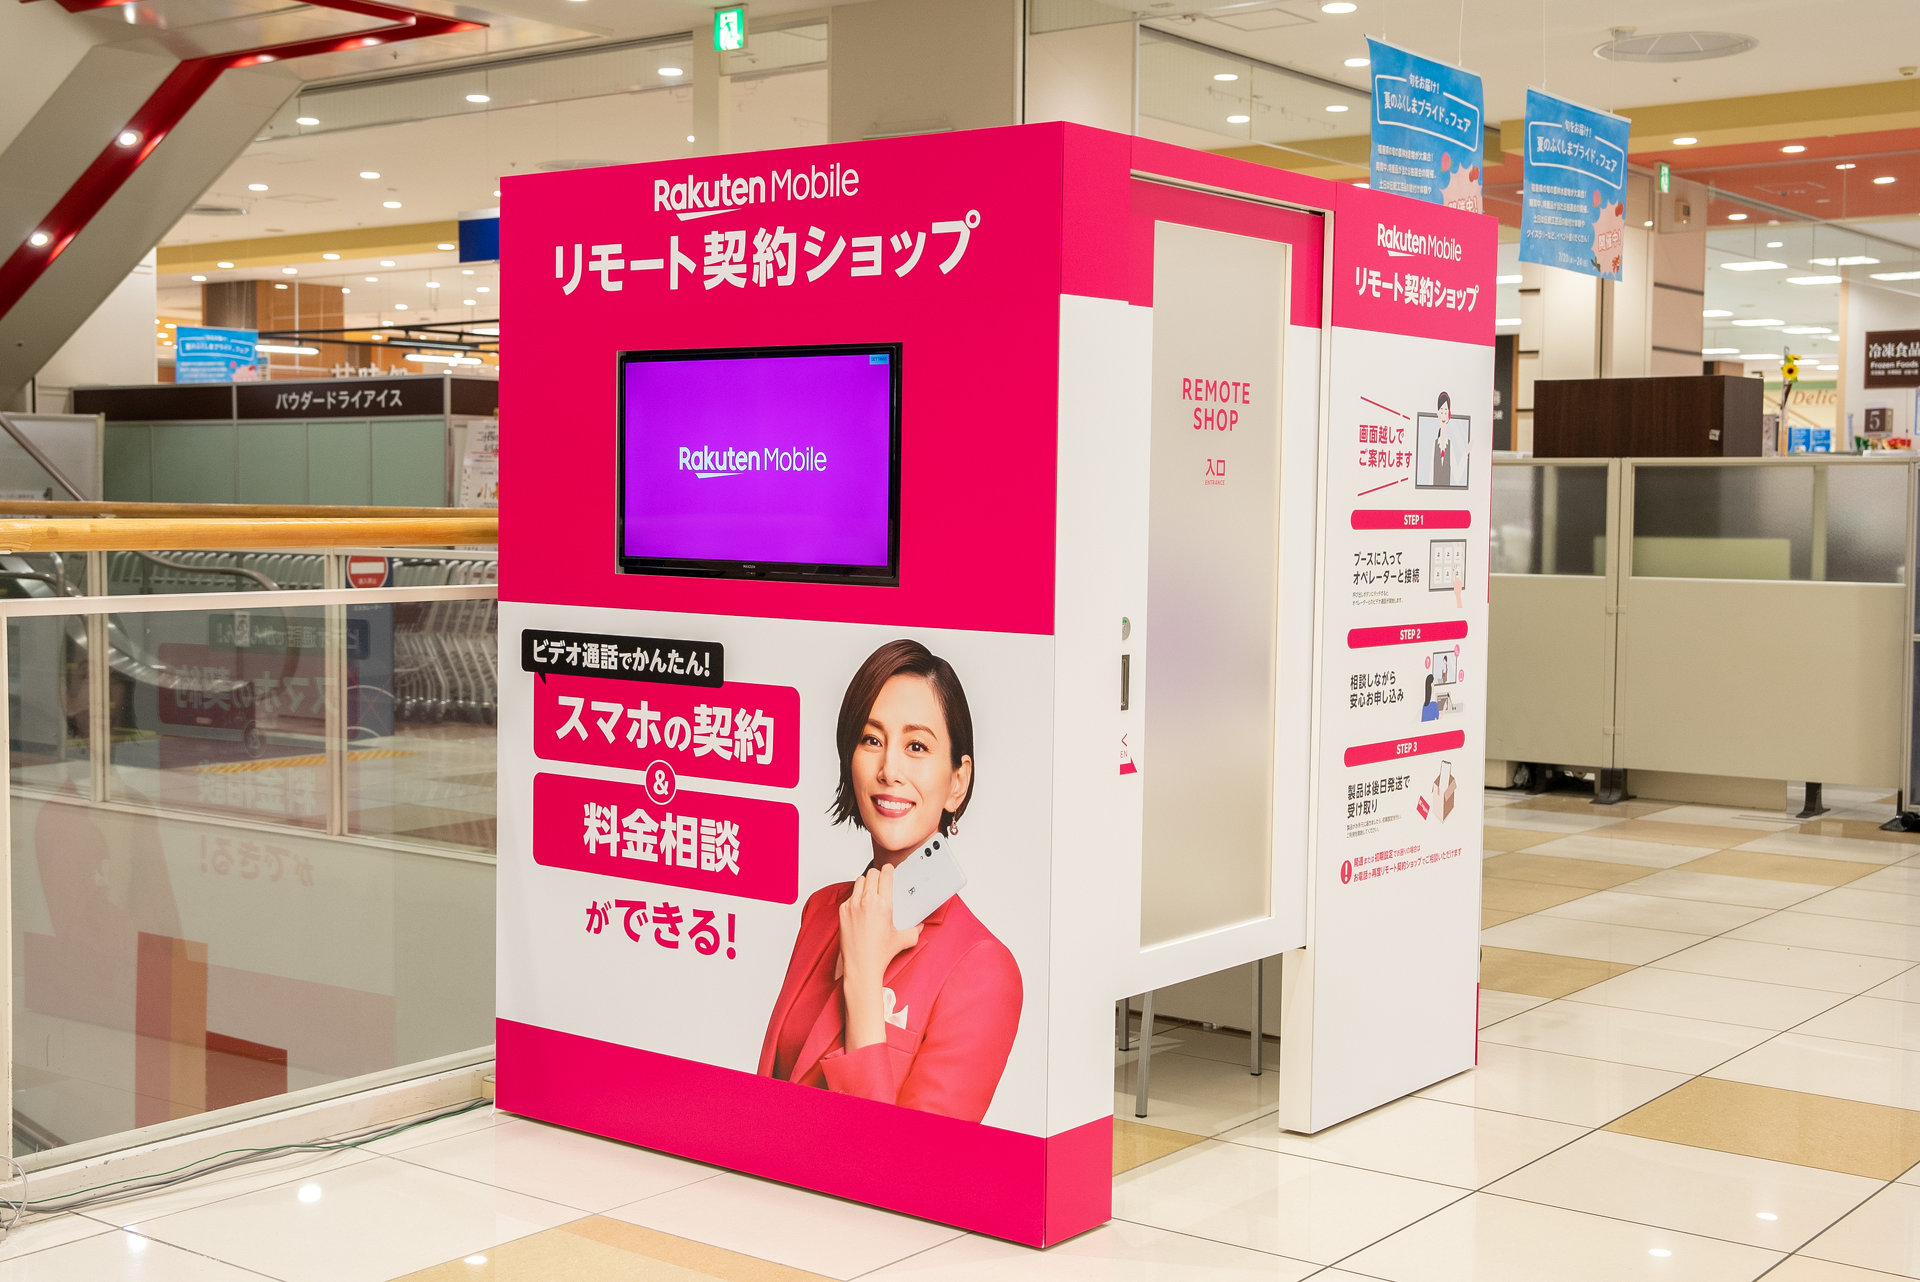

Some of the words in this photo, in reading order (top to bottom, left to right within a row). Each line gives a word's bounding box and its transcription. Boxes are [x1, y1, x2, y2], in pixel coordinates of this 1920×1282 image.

[1384, 91, 1471, 133] 夏のふくしまプライド。フェア
[654, 173, 766, 213] Rakuten
[770, 161, 860, 202] Mobile
[554, 209, 981, 297] リモート契約ショップ
[1377, 222, 1427, 255] Rakuten
[1427, 234, 1462, 262] Mobile
[1355, 266, 1480, 313] リモート契約ショップ
[1869, 342, 1920, 359] 冷凍食品
[1870, 361, 1895, 370] Frozen
[1895, 360, 1920, 369] Foods
[275, 389, 403, 411] パウダードライアイス
[1182, 377, 1251, 405] REMOTE
[1193, 406, 1239, 432] SHOP
[1869, 410, 1880, 430] 5
[1359, 424, 1404, 444] 画面越しで
[679, 445, 760, 471] Rakuten
[764, 446, 827, 471] Mobile
[1205, 458, 1226, 476] 入口
[1359, 448, 1413, 469] ご案内します
[1403, 514, 1419, 525] STEP
[1420, 514, 1424, 525] 1
[1354, 551, 1402, 566] ブースに入って
[1353, 568, 1420, 586] オペレーターと接続
[1400, 629, 1416, 640] STEP
[1416, 628, 1421, 639] 2
[532, 638, 711, 677] ビデオ通話でかんたん!
[1350, 671, 1396, 690] 相談しながら
[1350, 688, 1404, 709] 安心お申し込み
[555, 695, 775, 765] スマホの契約
[1396, 742, 1412, 755] STEP
[1413, 741, 1418, 752] 3
[653, 769, 670, 796] &
[1347, 775, 1411, 801] 製品は後日発送で
[1347, 798, 1378, 819] 受け取り
[583, 802, 741, 876] 料金相談
[585, 898, 737, 961] ができる!
